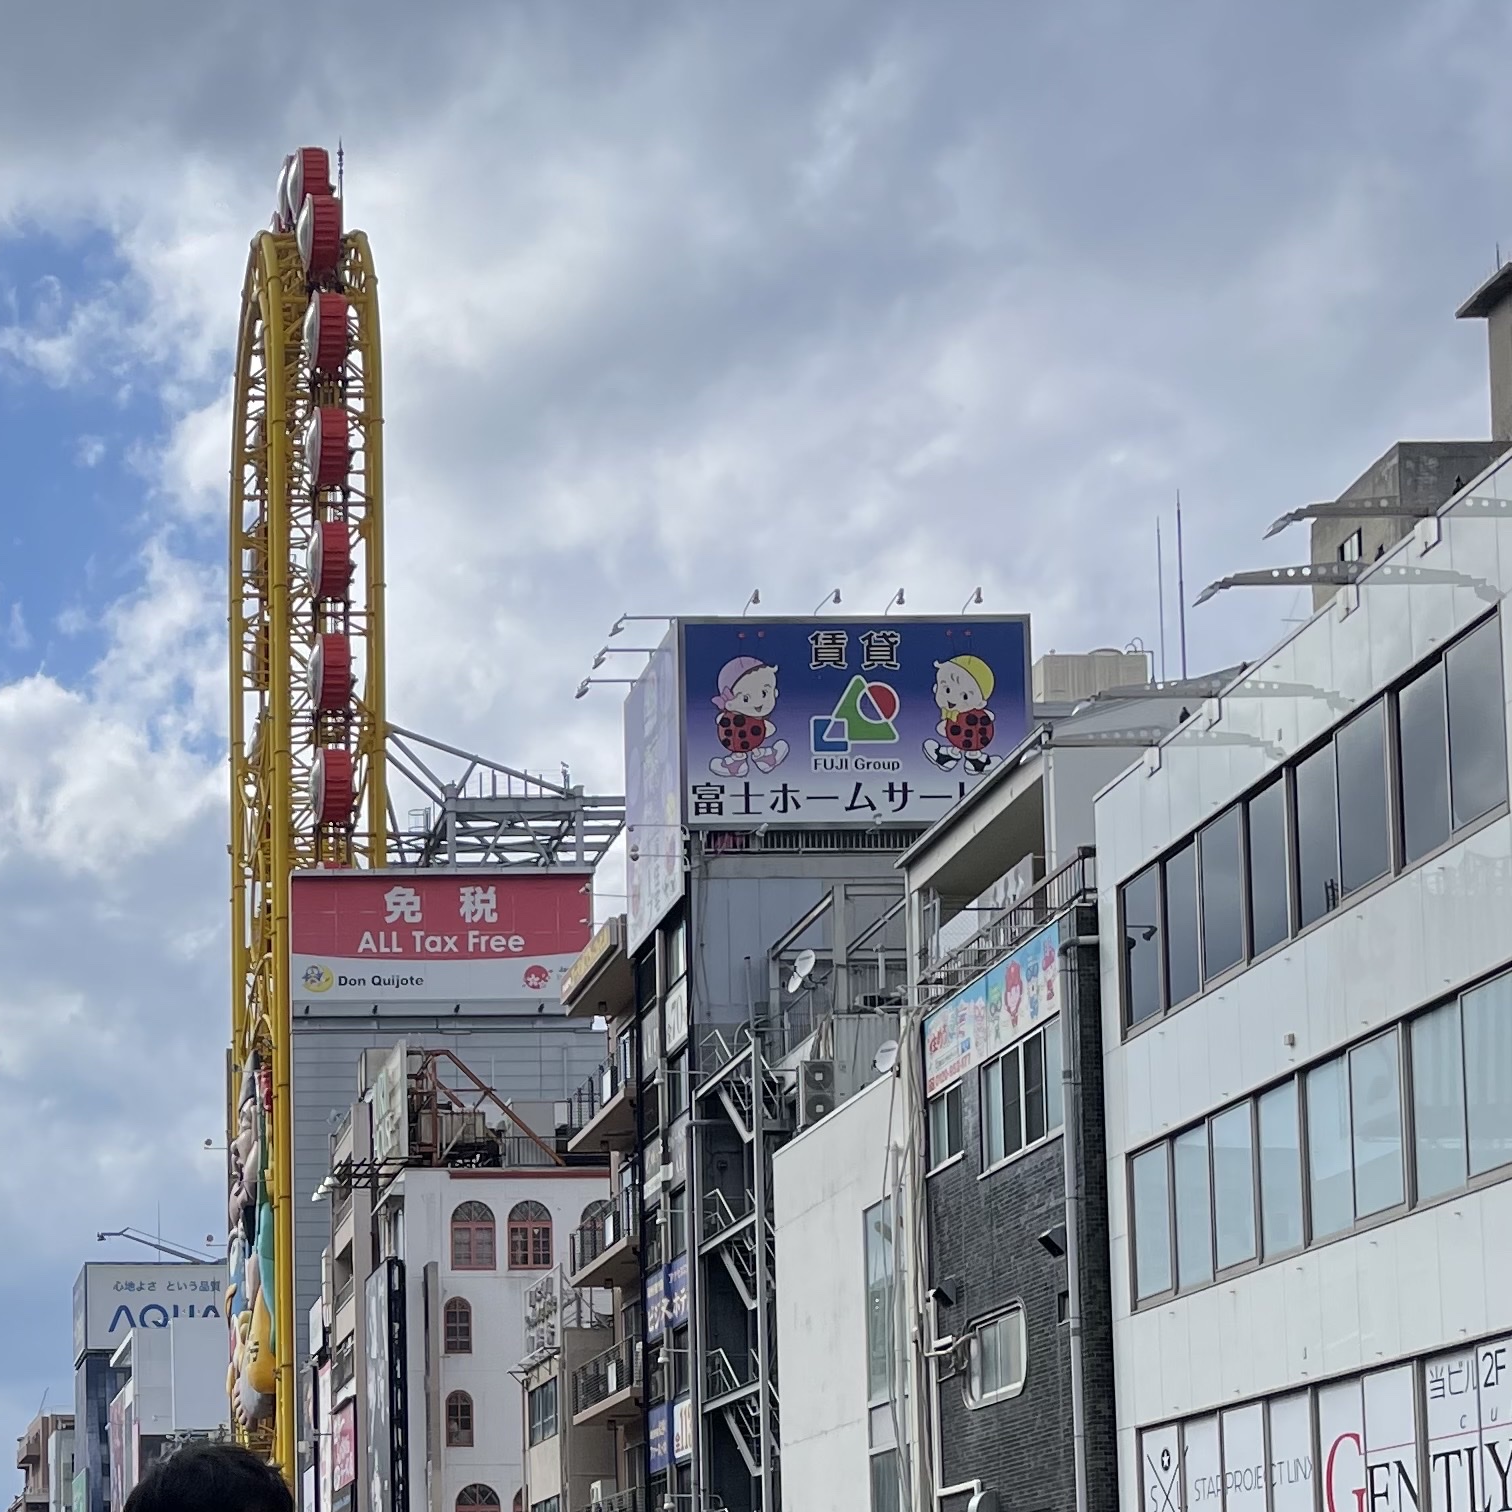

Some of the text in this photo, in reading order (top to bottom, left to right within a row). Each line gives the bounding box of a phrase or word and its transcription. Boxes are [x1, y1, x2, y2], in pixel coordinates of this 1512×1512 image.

[808, 630, 901, 670] 賃貸
[813, 757, 901, 773] FUJI Group
[357, 930, 525, 953] ALL Tax Free
[338, 975, 424, 989] Don Quijote
[1481, 1348, 1507, 1389] 2F
